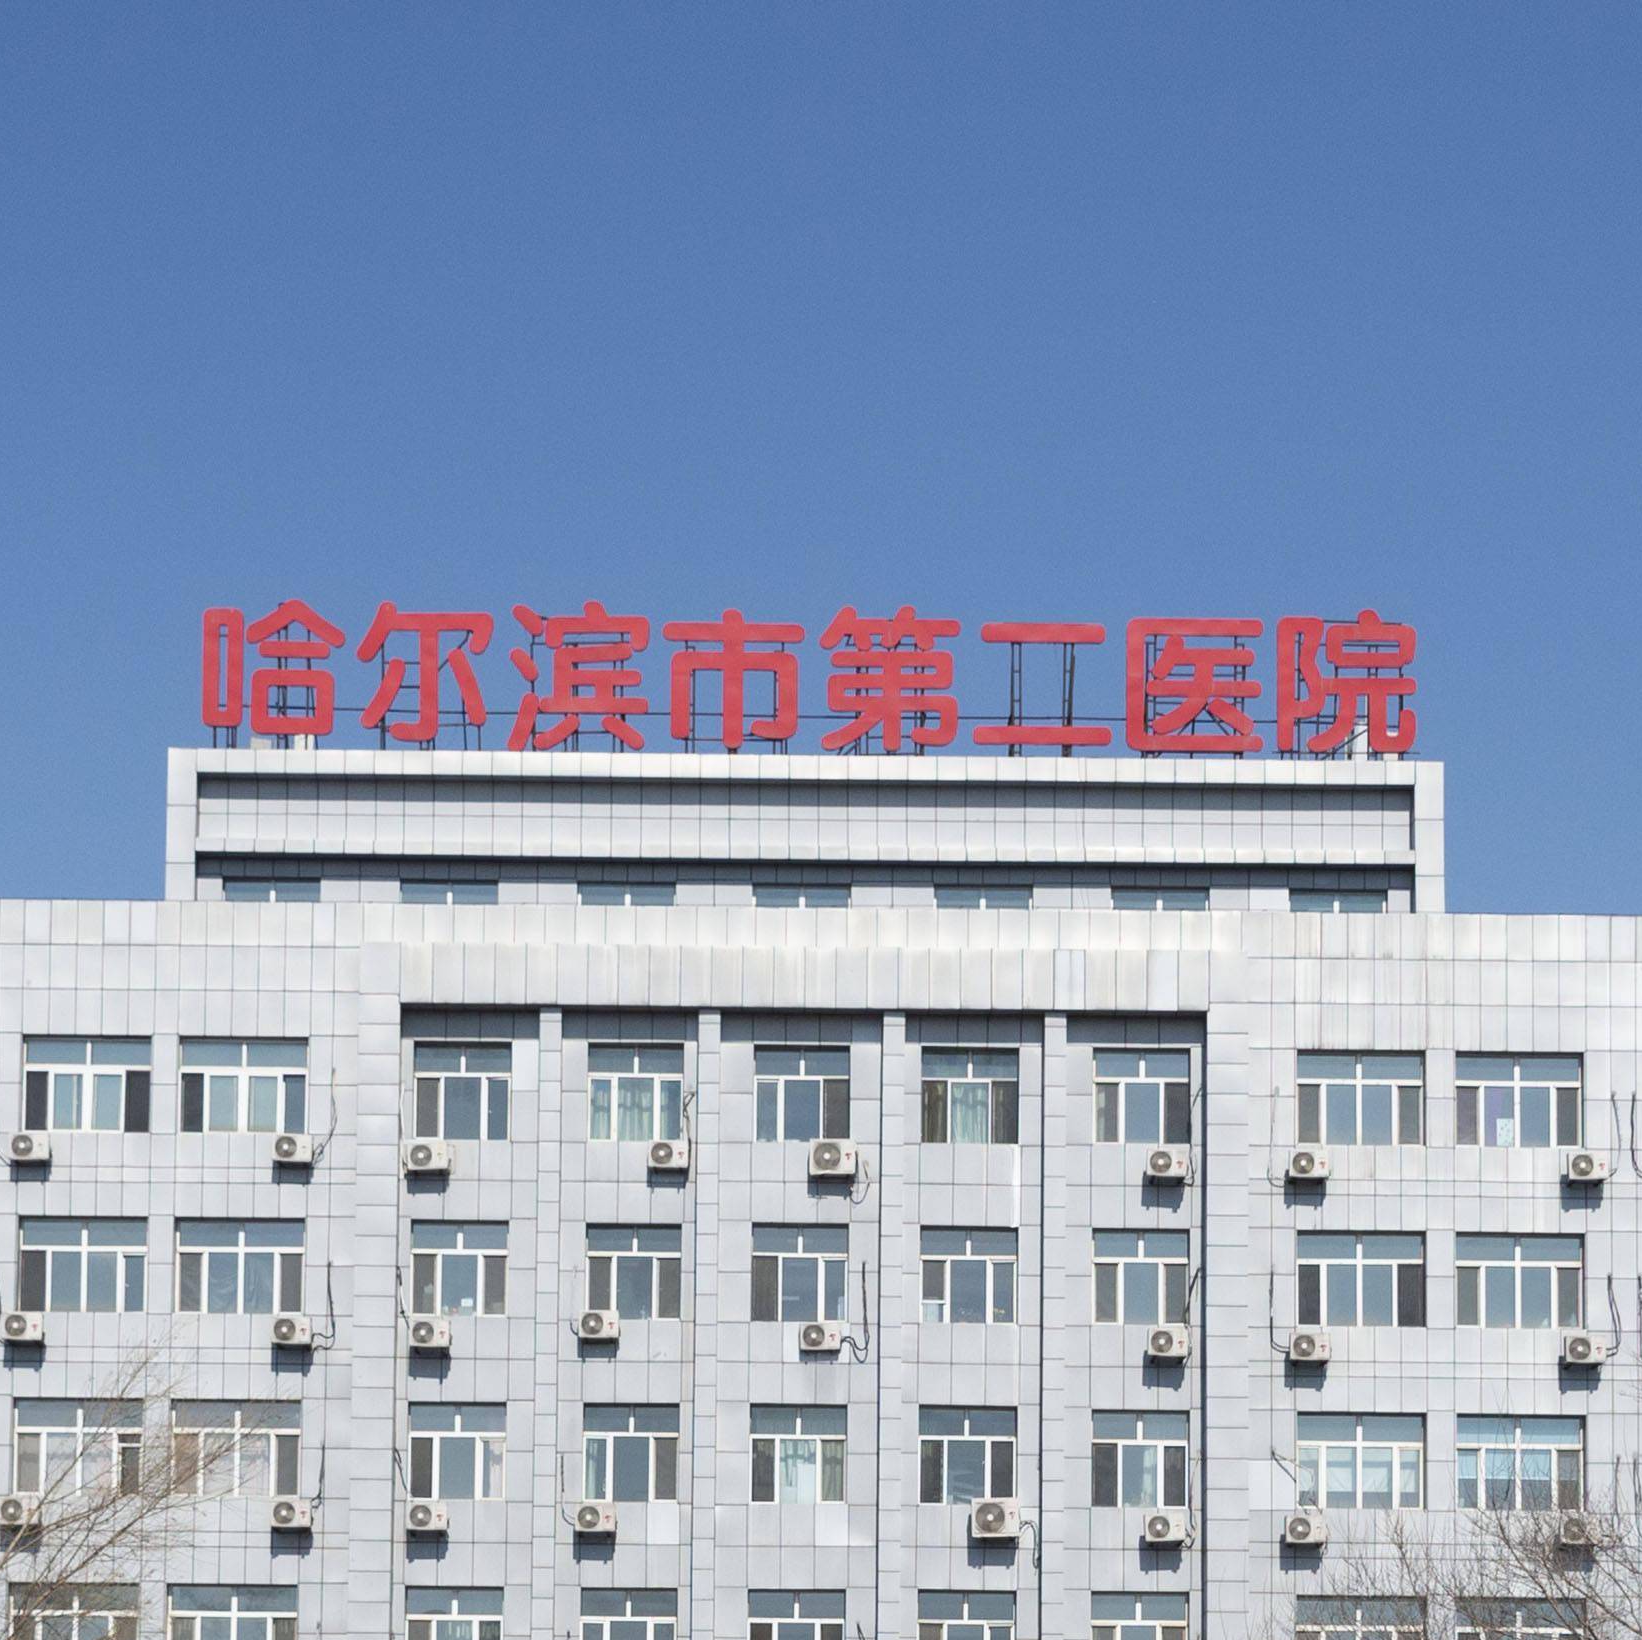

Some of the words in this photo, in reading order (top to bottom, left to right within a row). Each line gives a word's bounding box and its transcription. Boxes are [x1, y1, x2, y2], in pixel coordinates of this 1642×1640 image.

[202, 600, 1418, 753] 哈尔滨市第二医院
